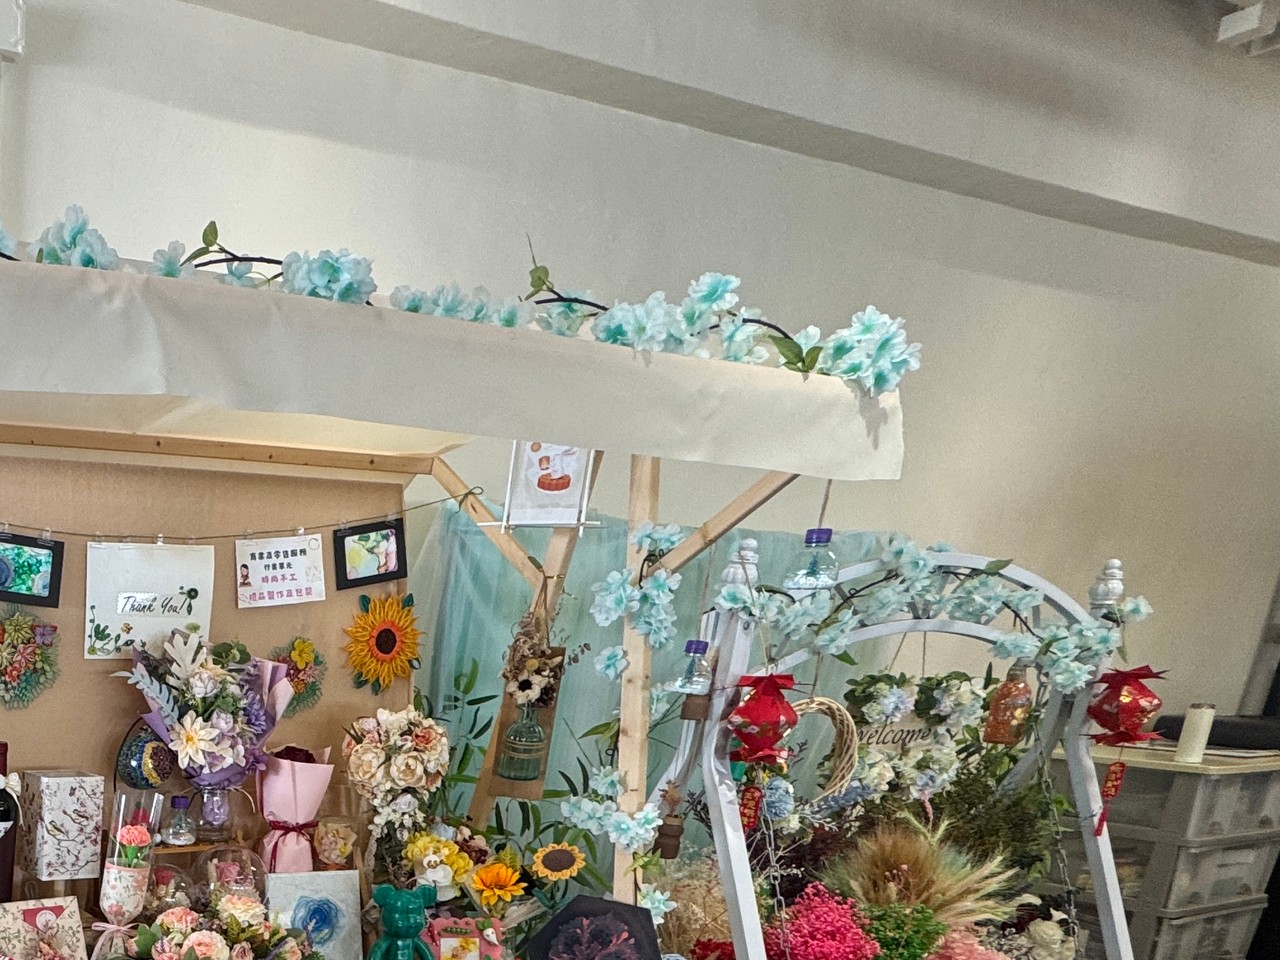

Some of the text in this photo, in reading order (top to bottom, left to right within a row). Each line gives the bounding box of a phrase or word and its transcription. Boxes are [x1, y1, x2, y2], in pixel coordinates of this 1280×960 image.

[121, 596, 188, 614] Thank You!
[857, 718, 932, 745] welcome
